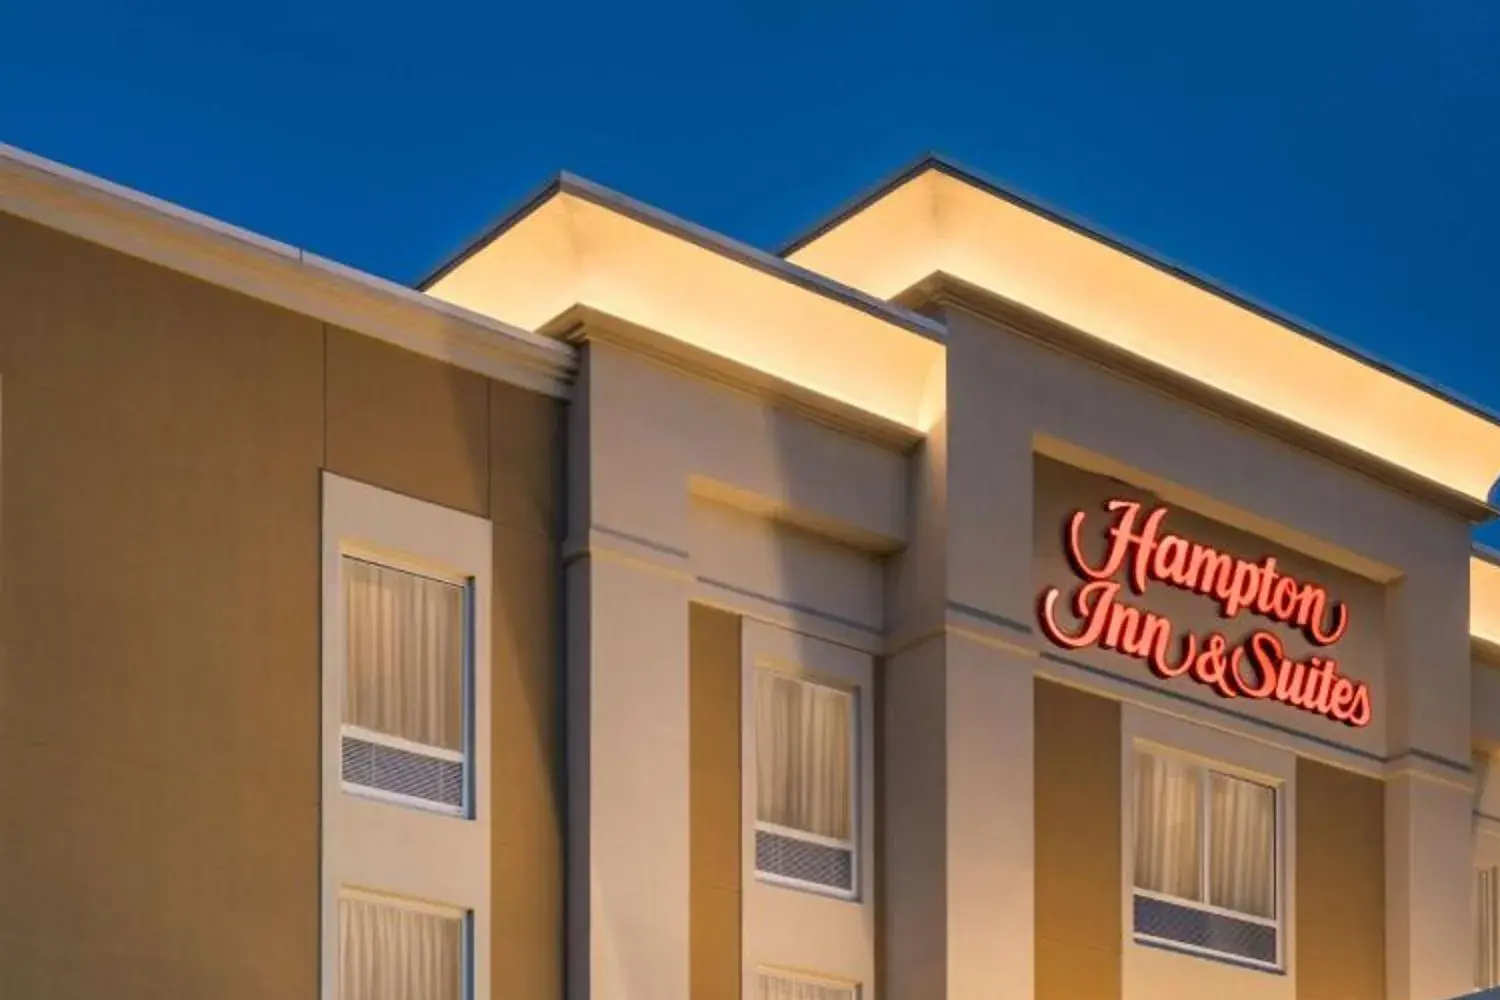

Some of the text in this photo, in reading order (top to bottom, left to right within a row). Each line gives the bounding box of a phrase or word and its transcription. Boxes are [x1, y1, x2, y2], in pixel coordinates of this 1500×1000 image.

[1066, 499, 1348, 645] Hampton
[1040, 580, 1372, 726] Inn & Suites
